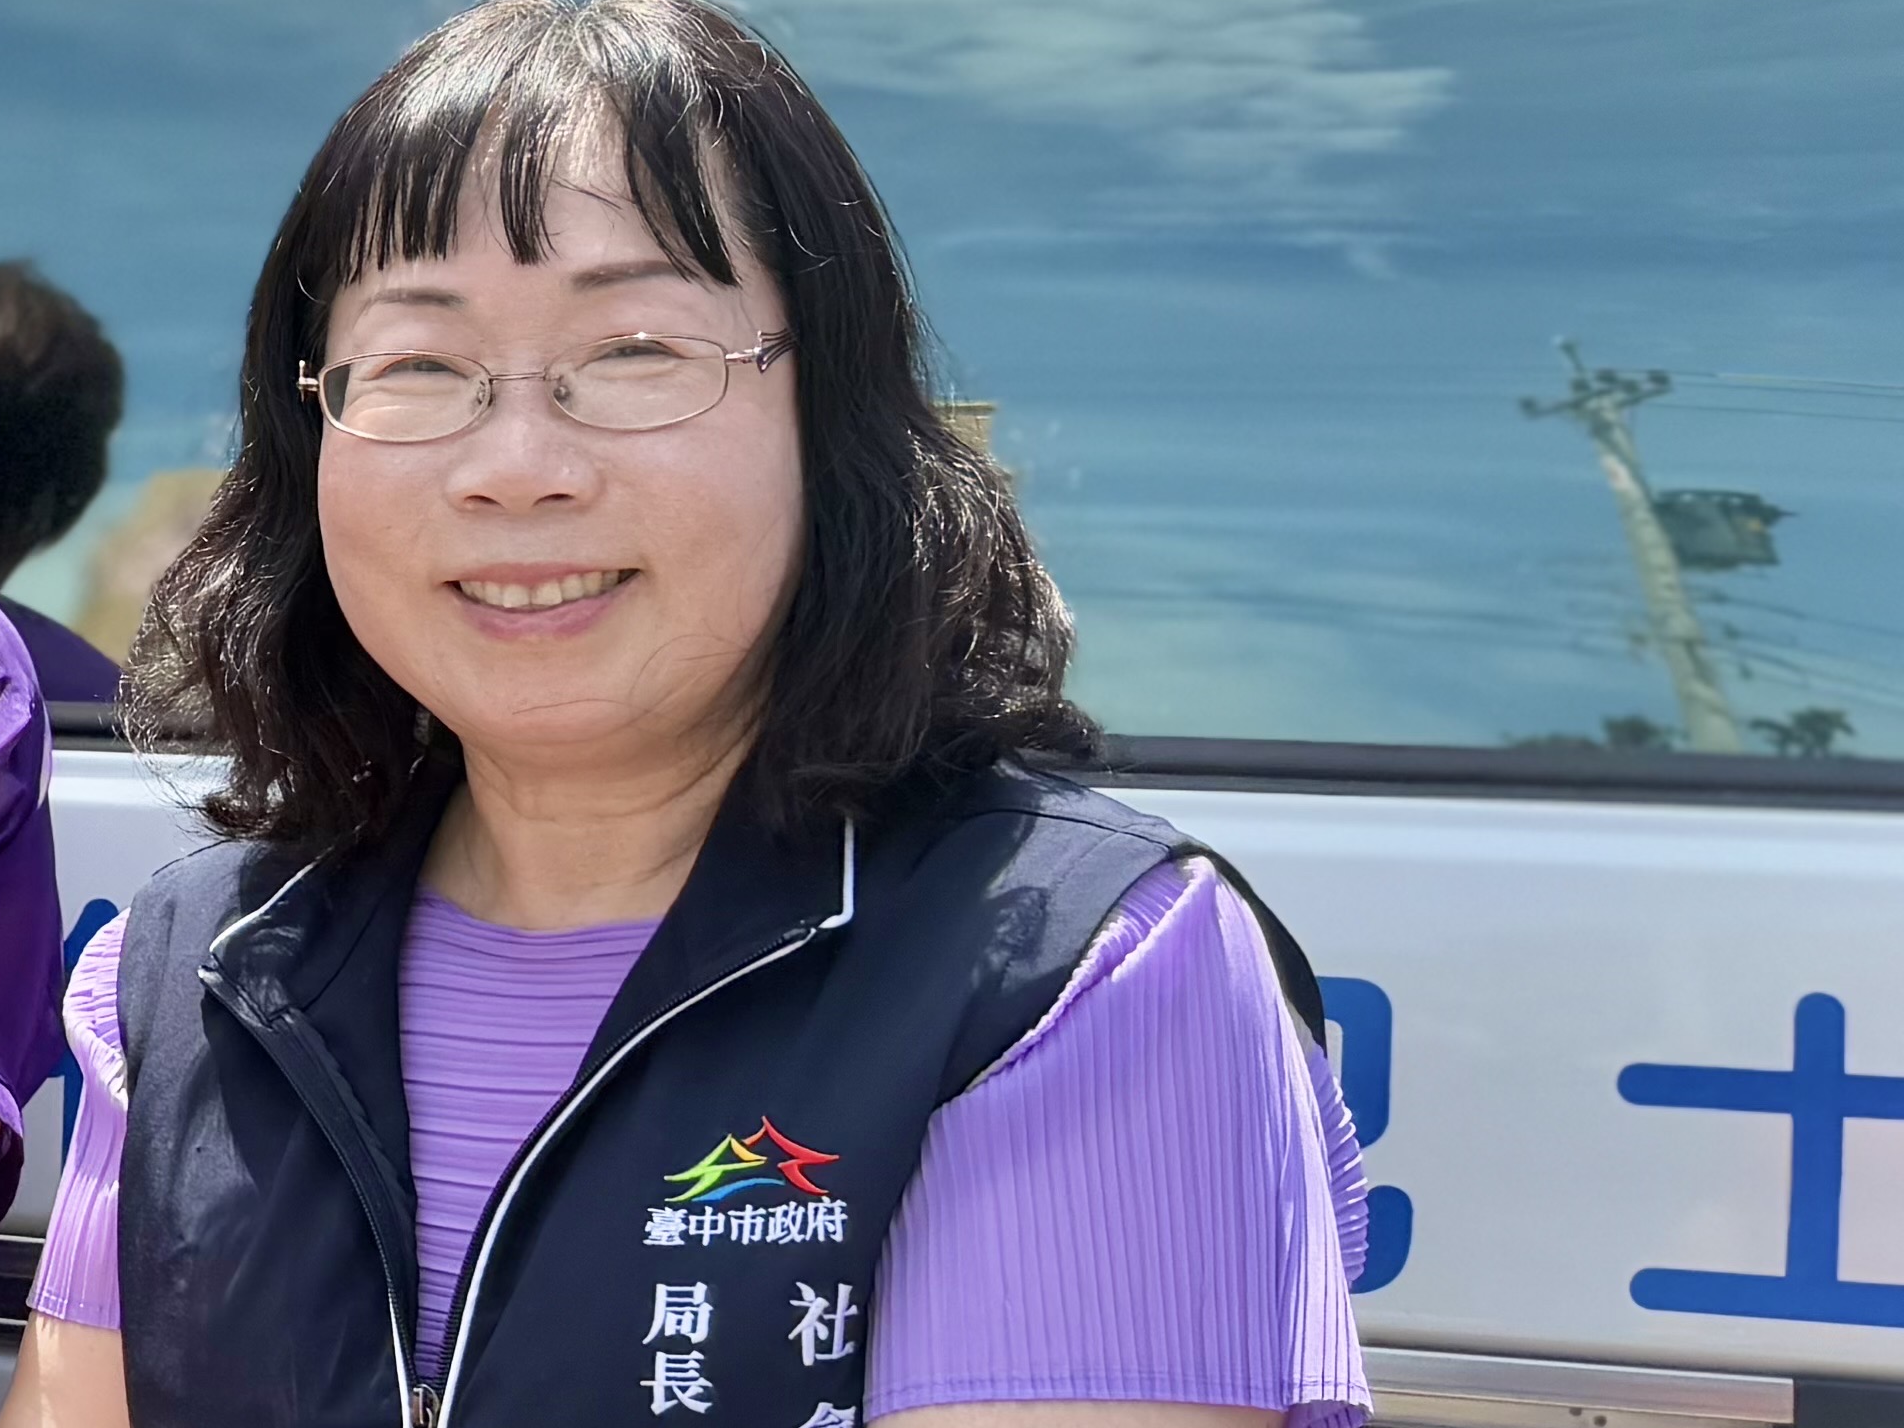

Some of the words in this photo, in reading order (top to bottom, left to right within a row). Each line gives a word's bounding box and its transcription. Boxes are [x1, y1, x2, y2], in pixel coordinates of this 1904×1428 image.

[642, 1196, 849, 1247] 臺中市政府
[639, 1280, 715, 1416] 局長
